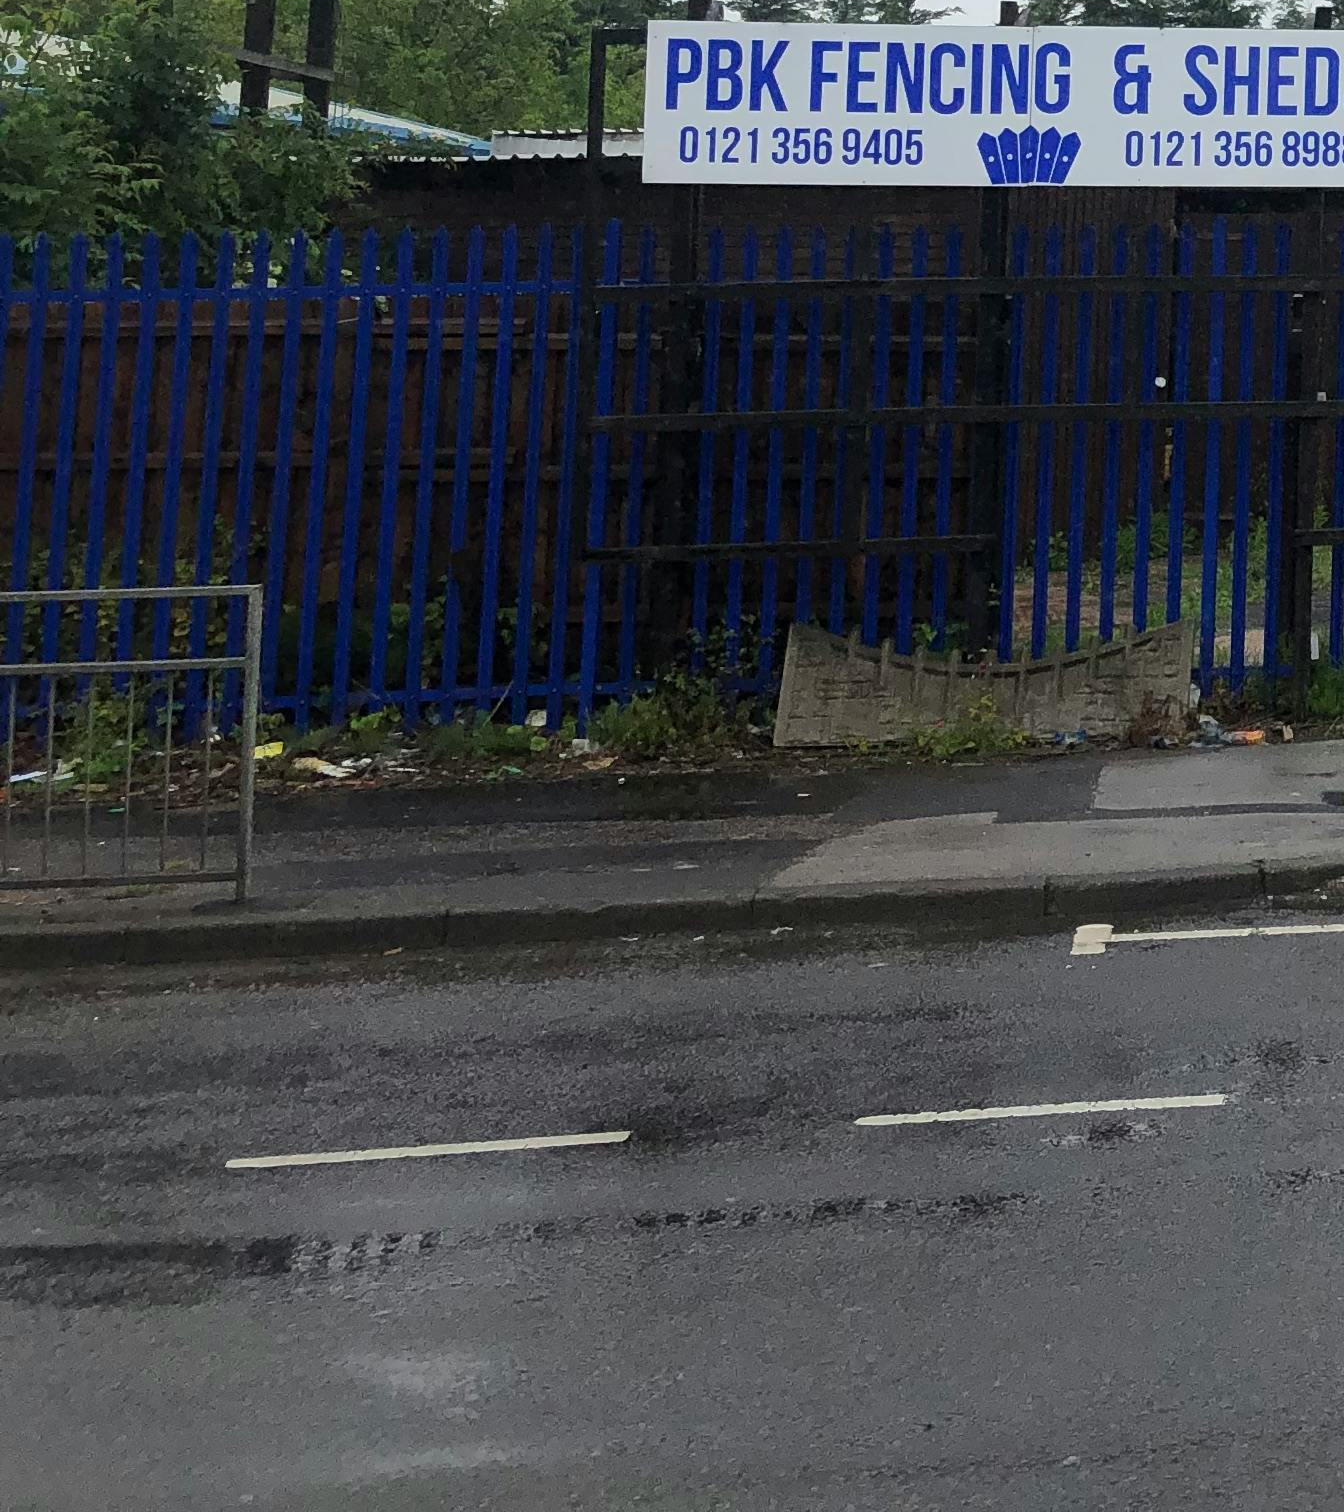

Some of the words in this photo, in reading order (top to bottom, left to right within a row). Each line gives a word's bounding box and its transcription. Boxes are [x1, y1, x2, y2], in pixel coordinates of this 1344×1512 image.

[665, 38, 788, 112] PBK
[809, 40, 1071, 115] FENCING
[1113, 44, 1152, 114] &
[679, 127, 759, 163] 0121
[772, 127, 832, 165] 356
[843, 128, 923, 165] 9405
[1126, 131, 1201, 166] 0121
[1215, 131, 1272, 167] 356
